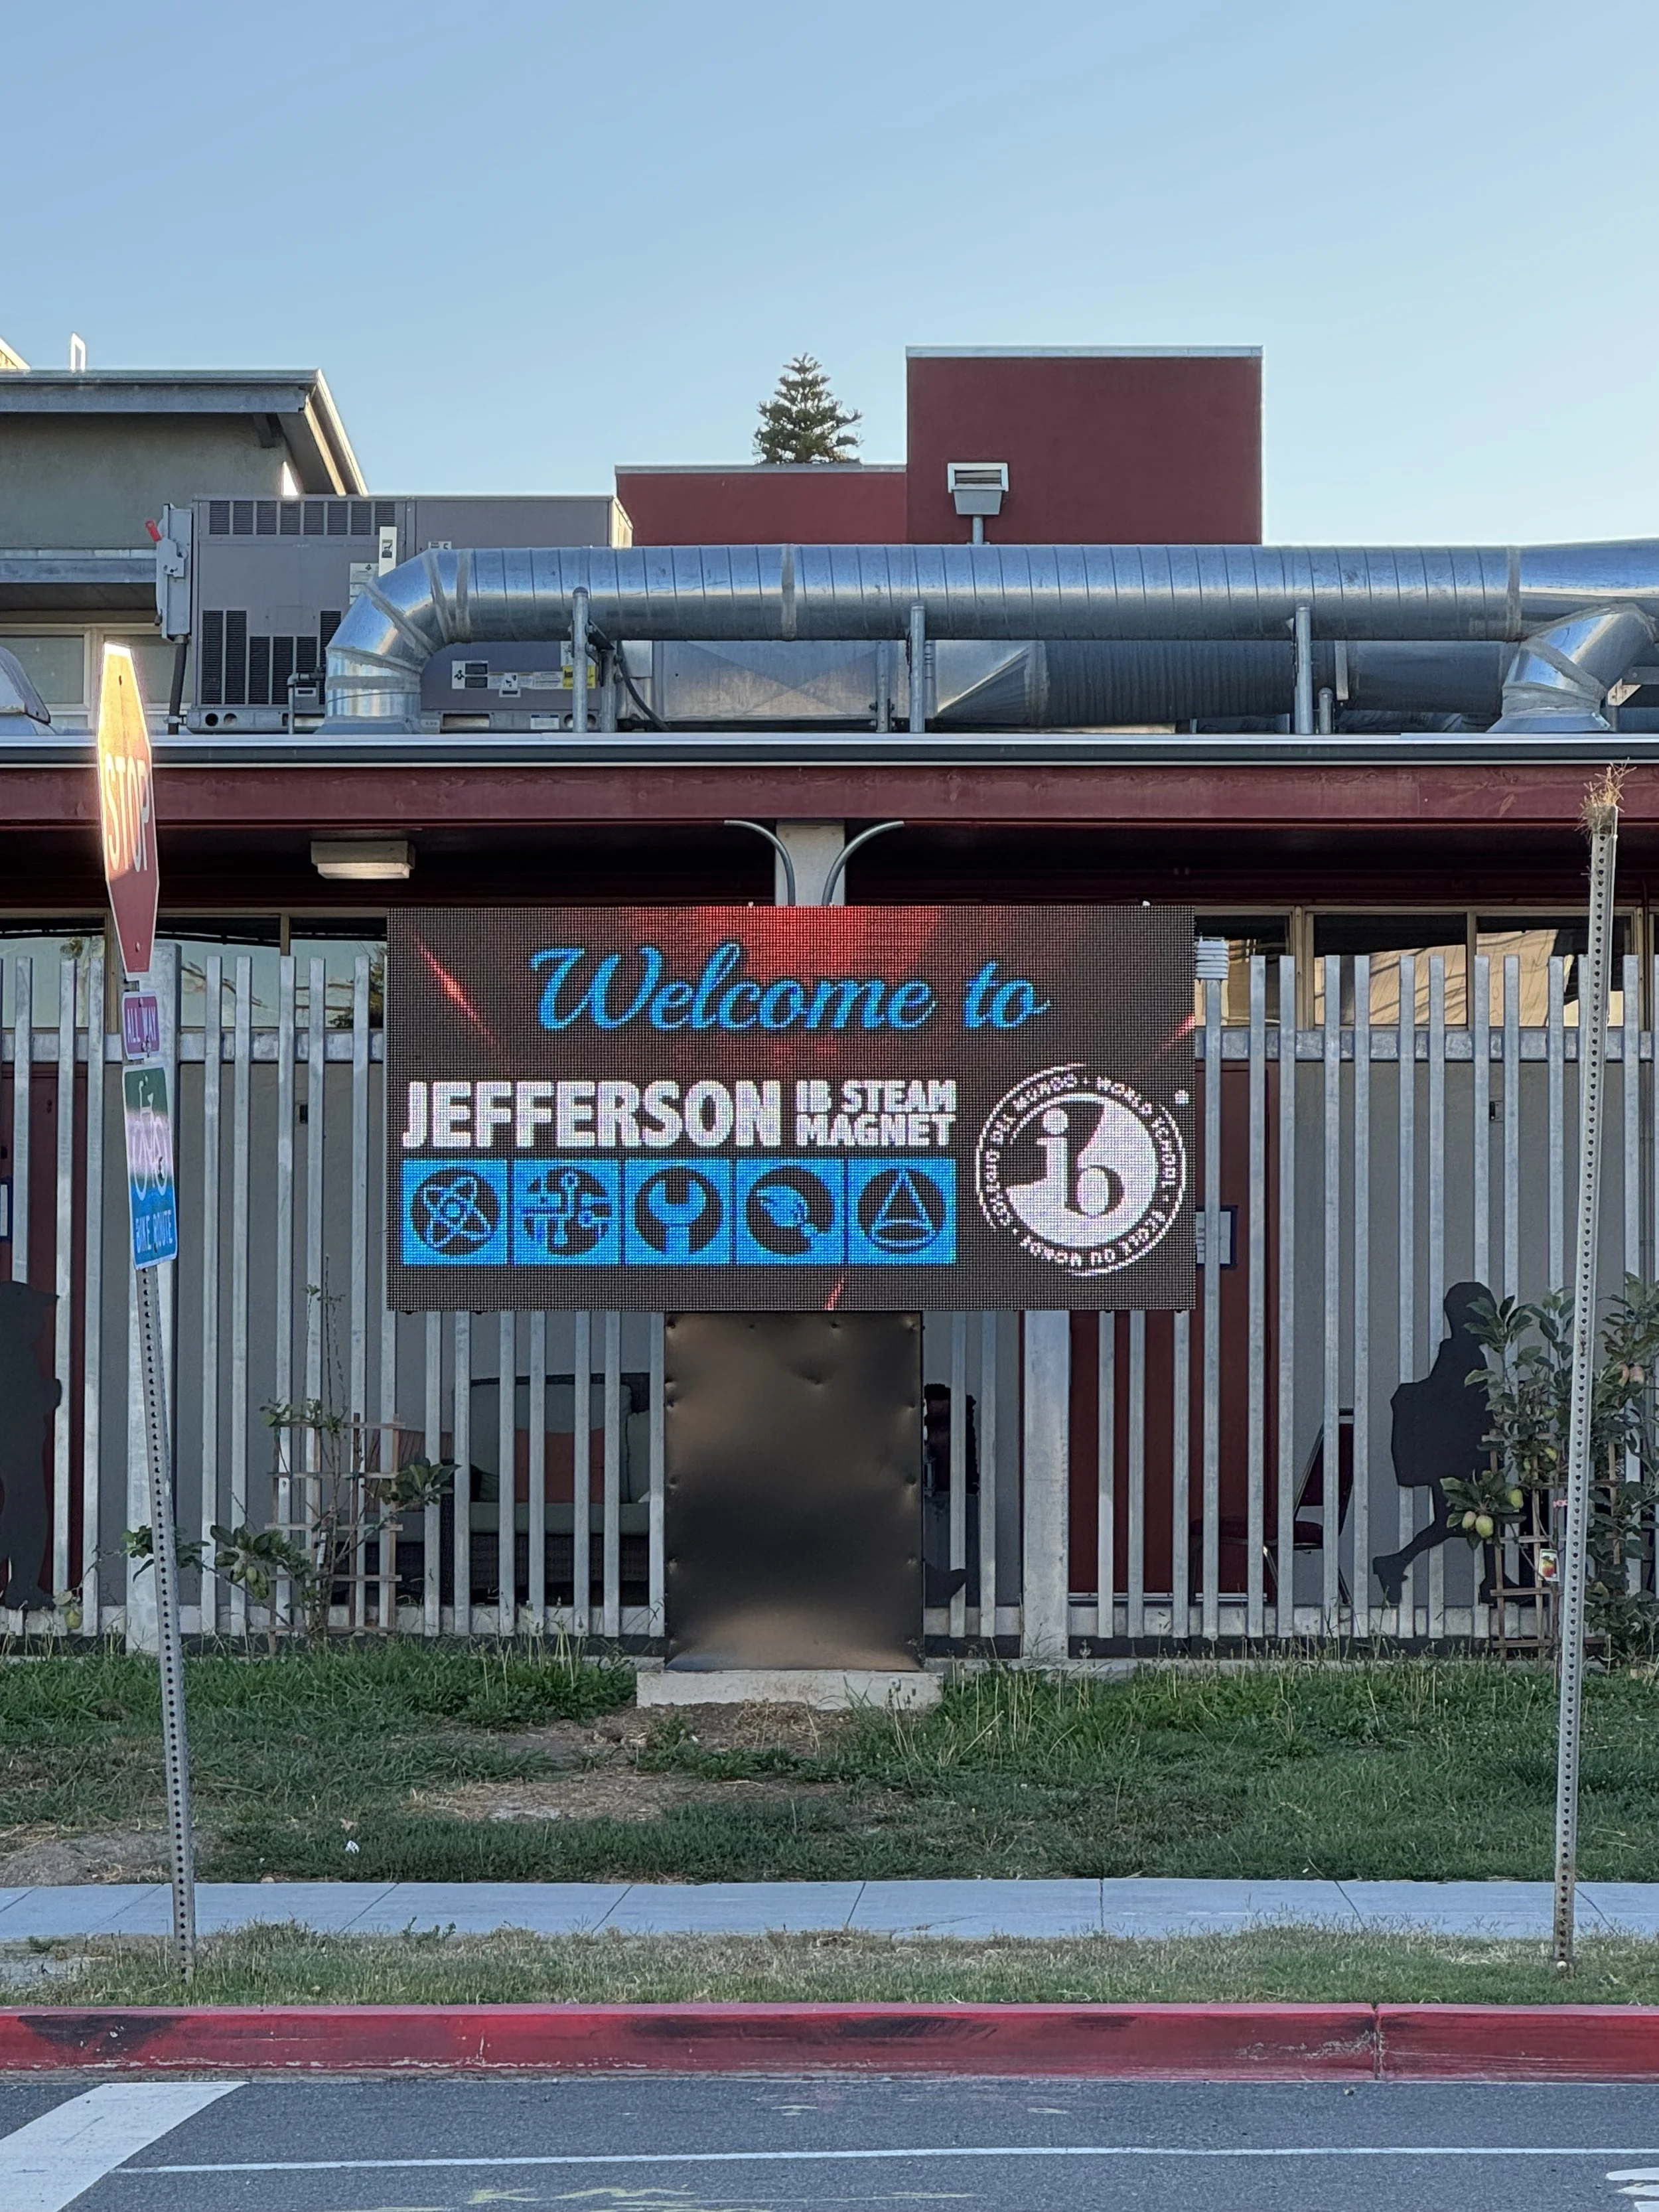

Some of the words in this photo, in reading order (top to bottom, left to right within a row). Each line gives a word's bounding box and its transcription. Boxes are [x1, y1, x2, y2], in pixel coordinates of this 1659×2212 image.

[104, 751, 151, 873] STOP
[531, 940, 936, 1030] Welcome
[964, 960, 1050, 1030] to
[127, 1007, 141, 1043] ALL
[141, 1005, 157, 1043] WAY
[402, 1080, 781, 1147] JEFFERSON
[796, 1080, 831, 1112] IB
[840, 1080, 956, 1112] STEAM
[1013, 1072, 1078, 1112] MUNDO
[796, 1114, 956, 1146] MAGNET
[1096, 1076, 1153, 1116] WORLD
[1151, 1116, 1177, 1189] SCHOOL
[135, 1215, 151, 1254] BIKE
[153, 1209, 173, 1248] ROUTE
